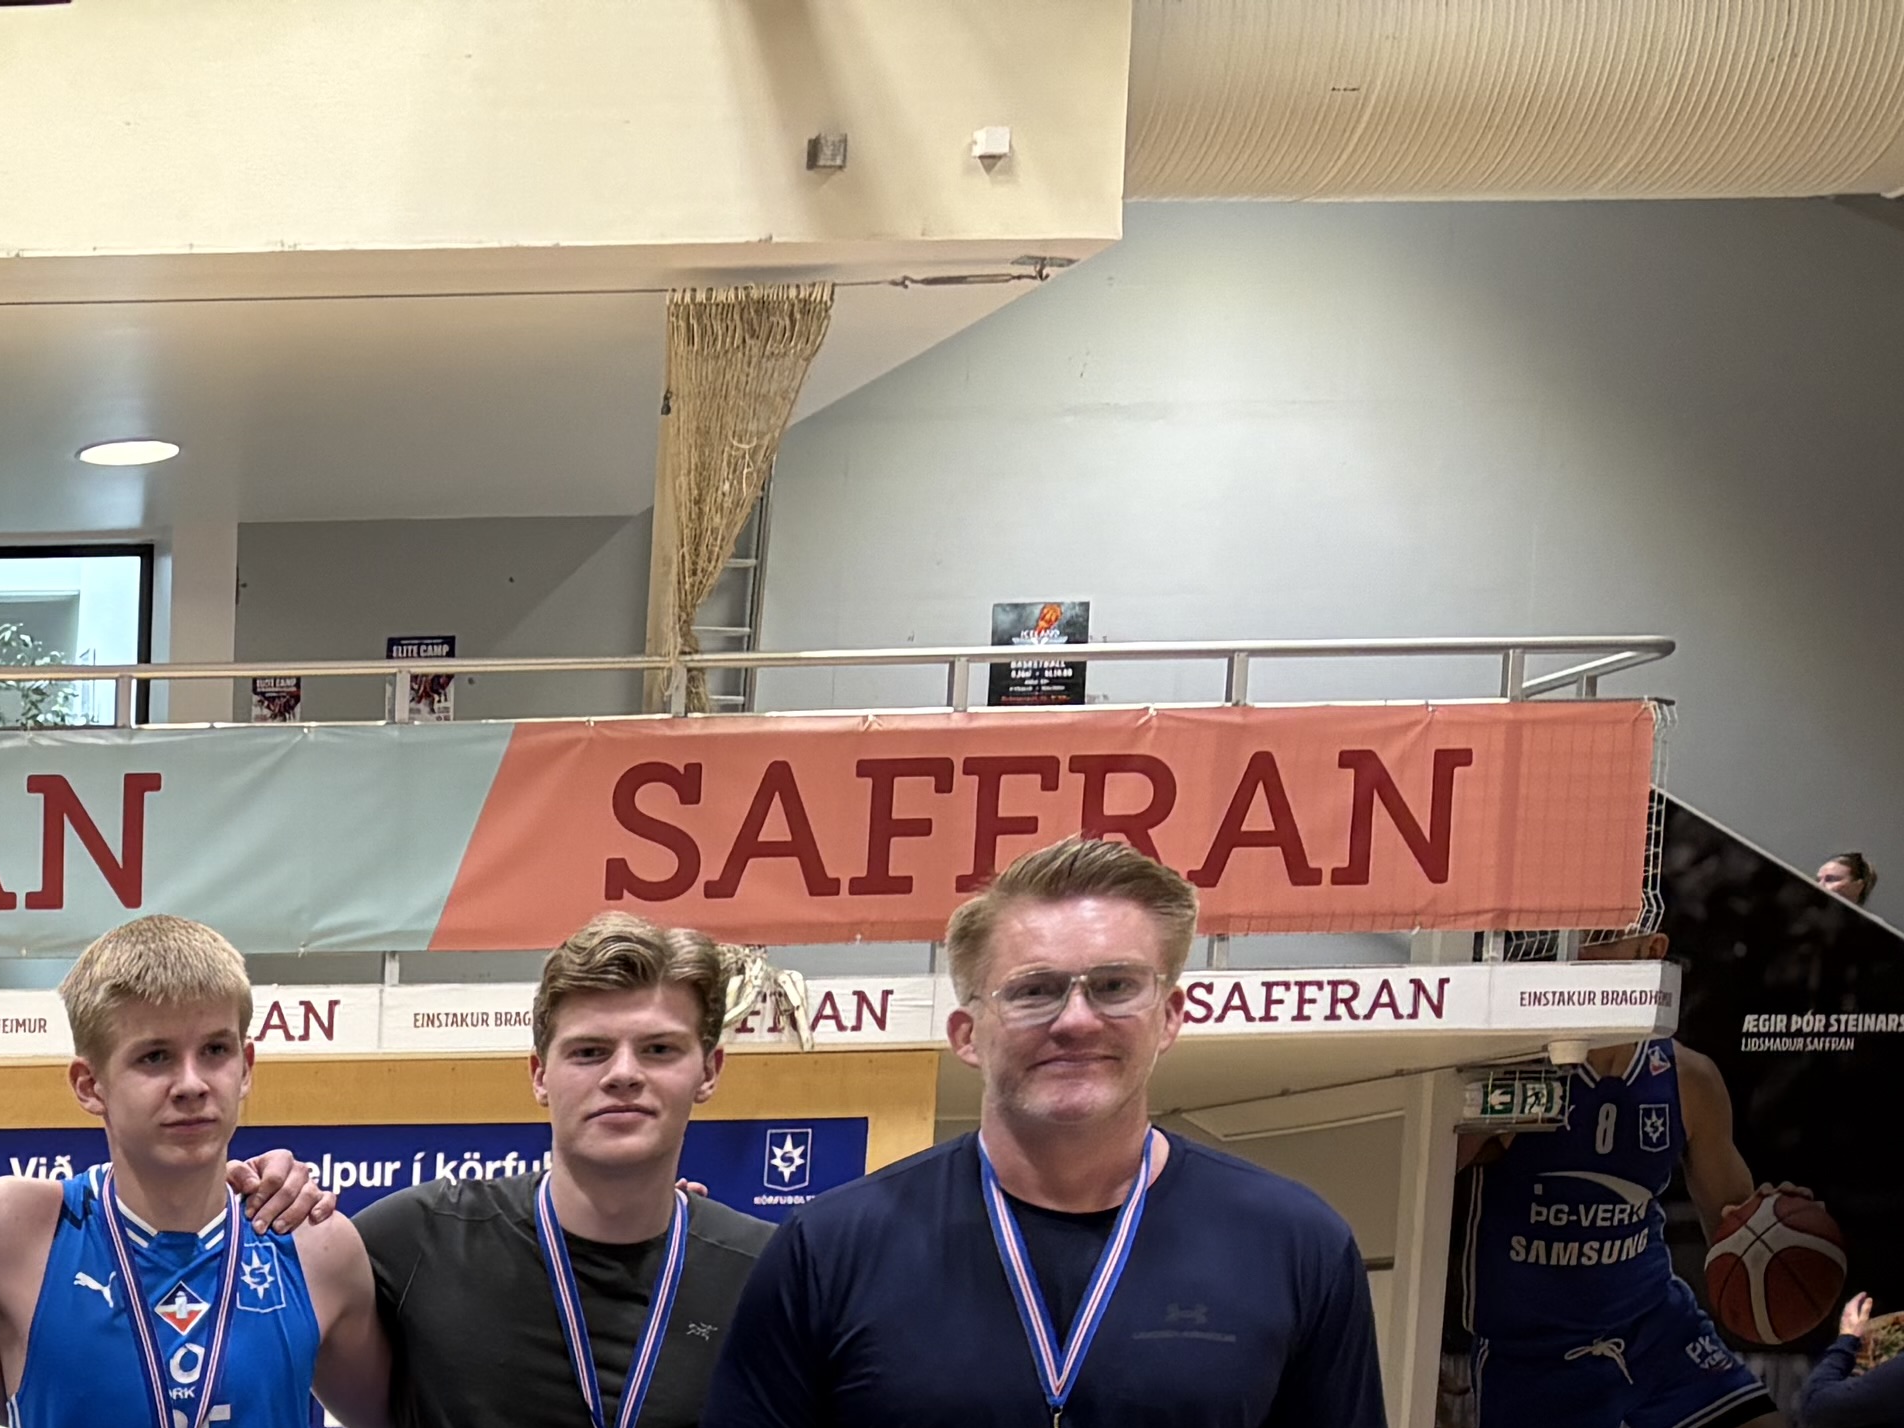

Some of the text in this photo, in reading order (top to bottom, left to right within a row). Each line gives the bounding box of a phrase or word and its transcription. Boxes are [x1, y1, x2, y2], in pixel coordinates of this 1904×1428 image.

[419, 644, 450, 657] CAMP
[603, 747, 1473, 902] SAFFRAN
[412, 1011, 490, 1030] EINSTAKUR
[1184, 977, 1451, 1025] SAFFRAN
[1519, 990, 1598, 1008] EINSTAKUR
[1742, 1013, 1787, 1033] ÆGIR
[1789, 1008, 1827, 1033] ÞÓR
[1594, 1102, 1618, 1155] 8
[9, 1145, 555, 1193] Við elpur í körfu
[1509, 1227, 1649, 1266] SAMSUNG
